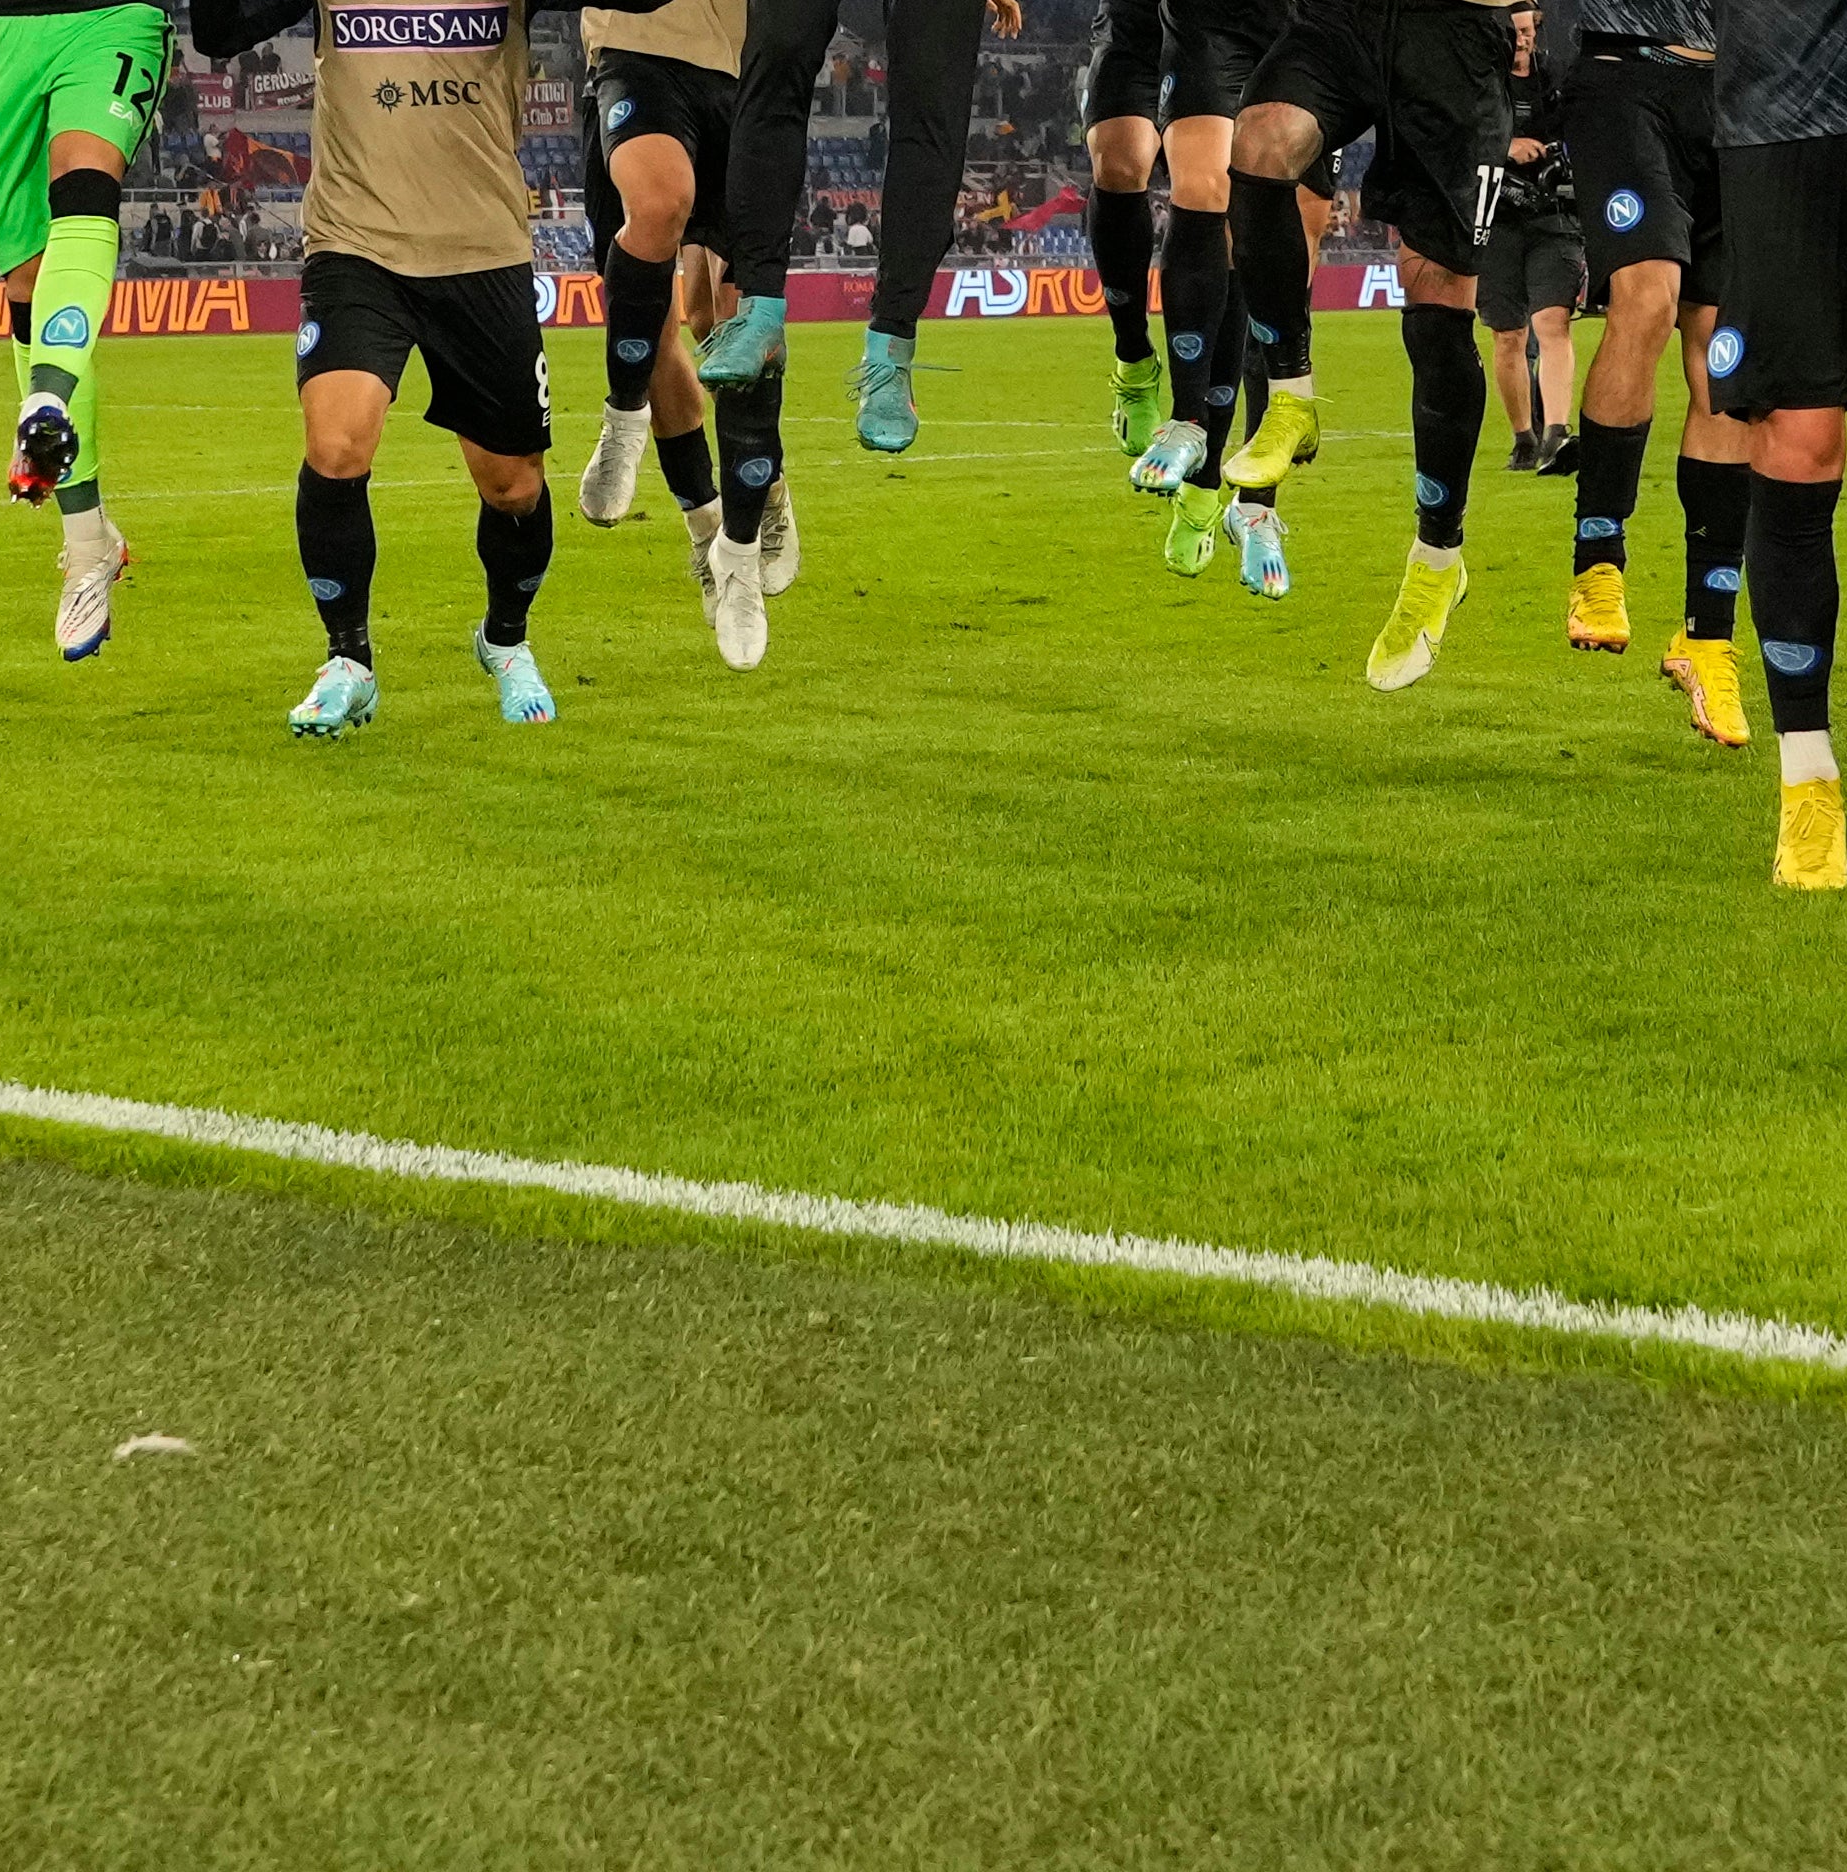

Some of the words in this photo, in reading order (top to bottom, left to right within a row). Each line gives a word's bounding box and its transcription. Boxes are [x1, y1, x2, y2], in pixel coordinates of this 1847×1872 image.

[112, 51, 155, 122] 12
[408, 80, 481, 107] MSC
[109, 101, 134, 125] EA
[1476, 164, 1504, 227] 17
